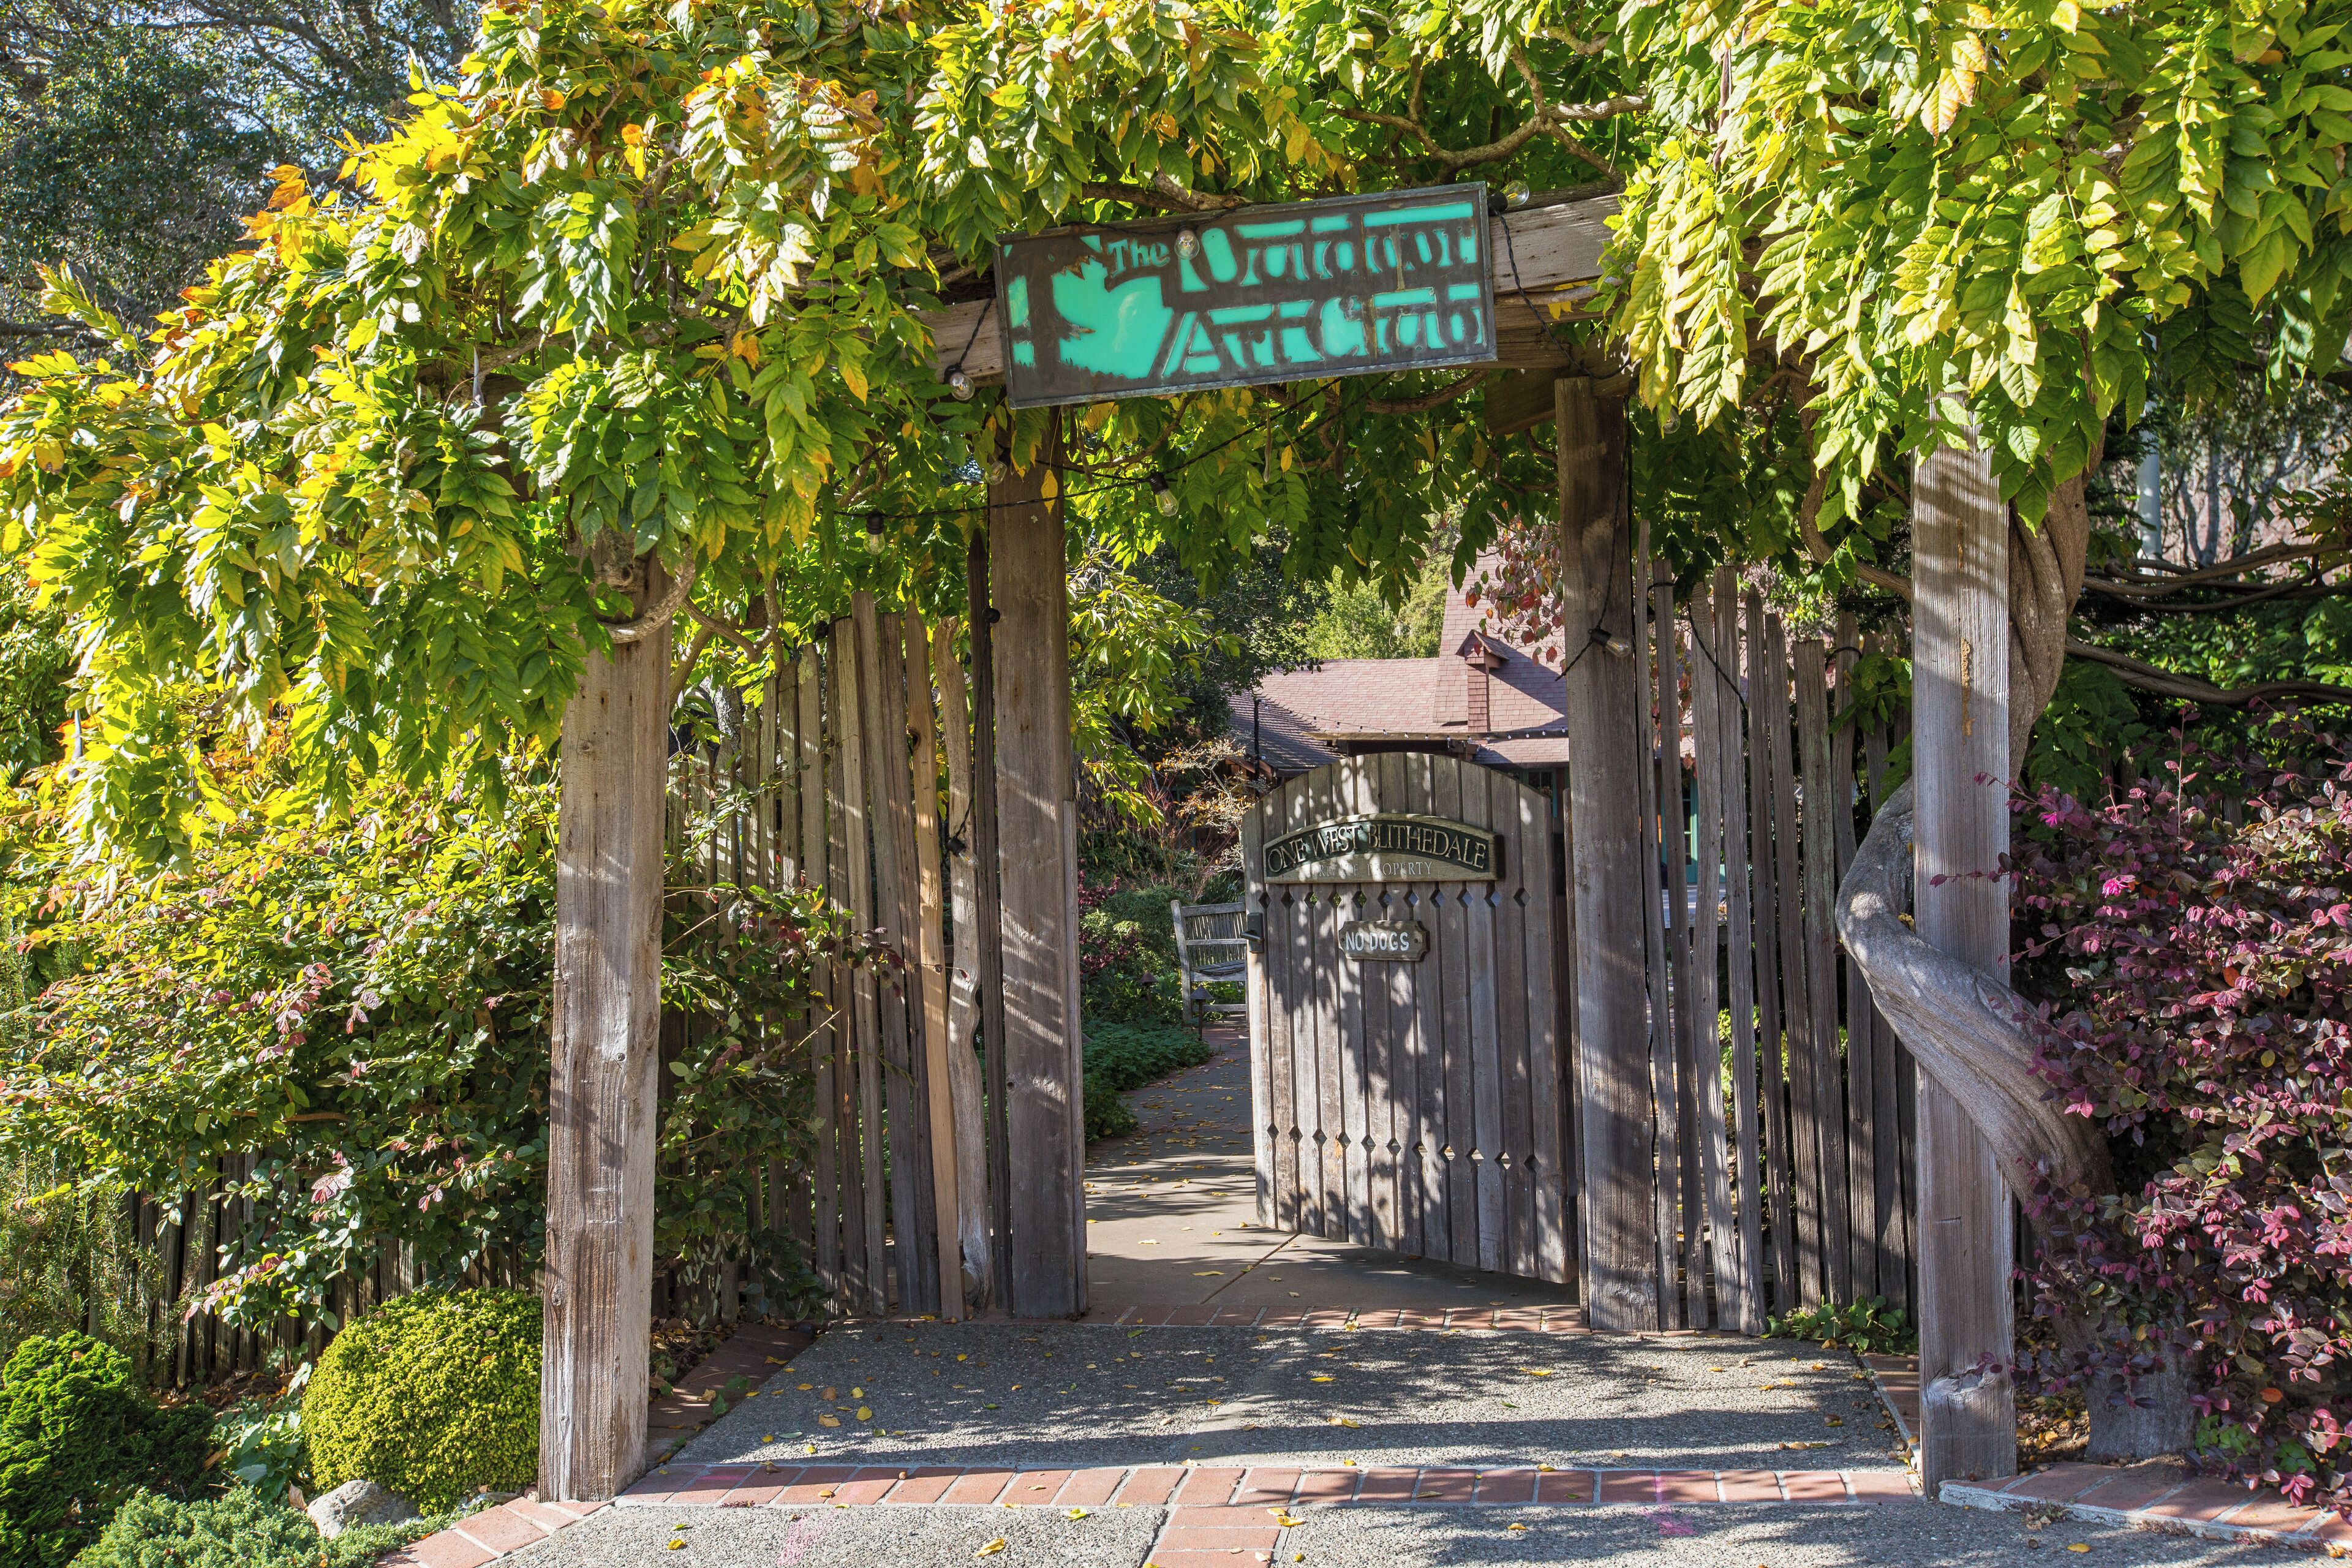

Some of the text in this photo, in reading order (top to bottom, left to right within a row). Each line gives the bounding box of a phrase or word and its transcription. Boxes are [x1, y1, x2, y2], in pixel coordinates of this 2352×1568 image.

[1107, 238, 1170, 278] The
[1268, 824, 1487, 873] ONE WEST BLITHEDALE
[1311, 864, 1359, 877] PRIVE
[1345, 931, 1409, 951] NO DOGS
